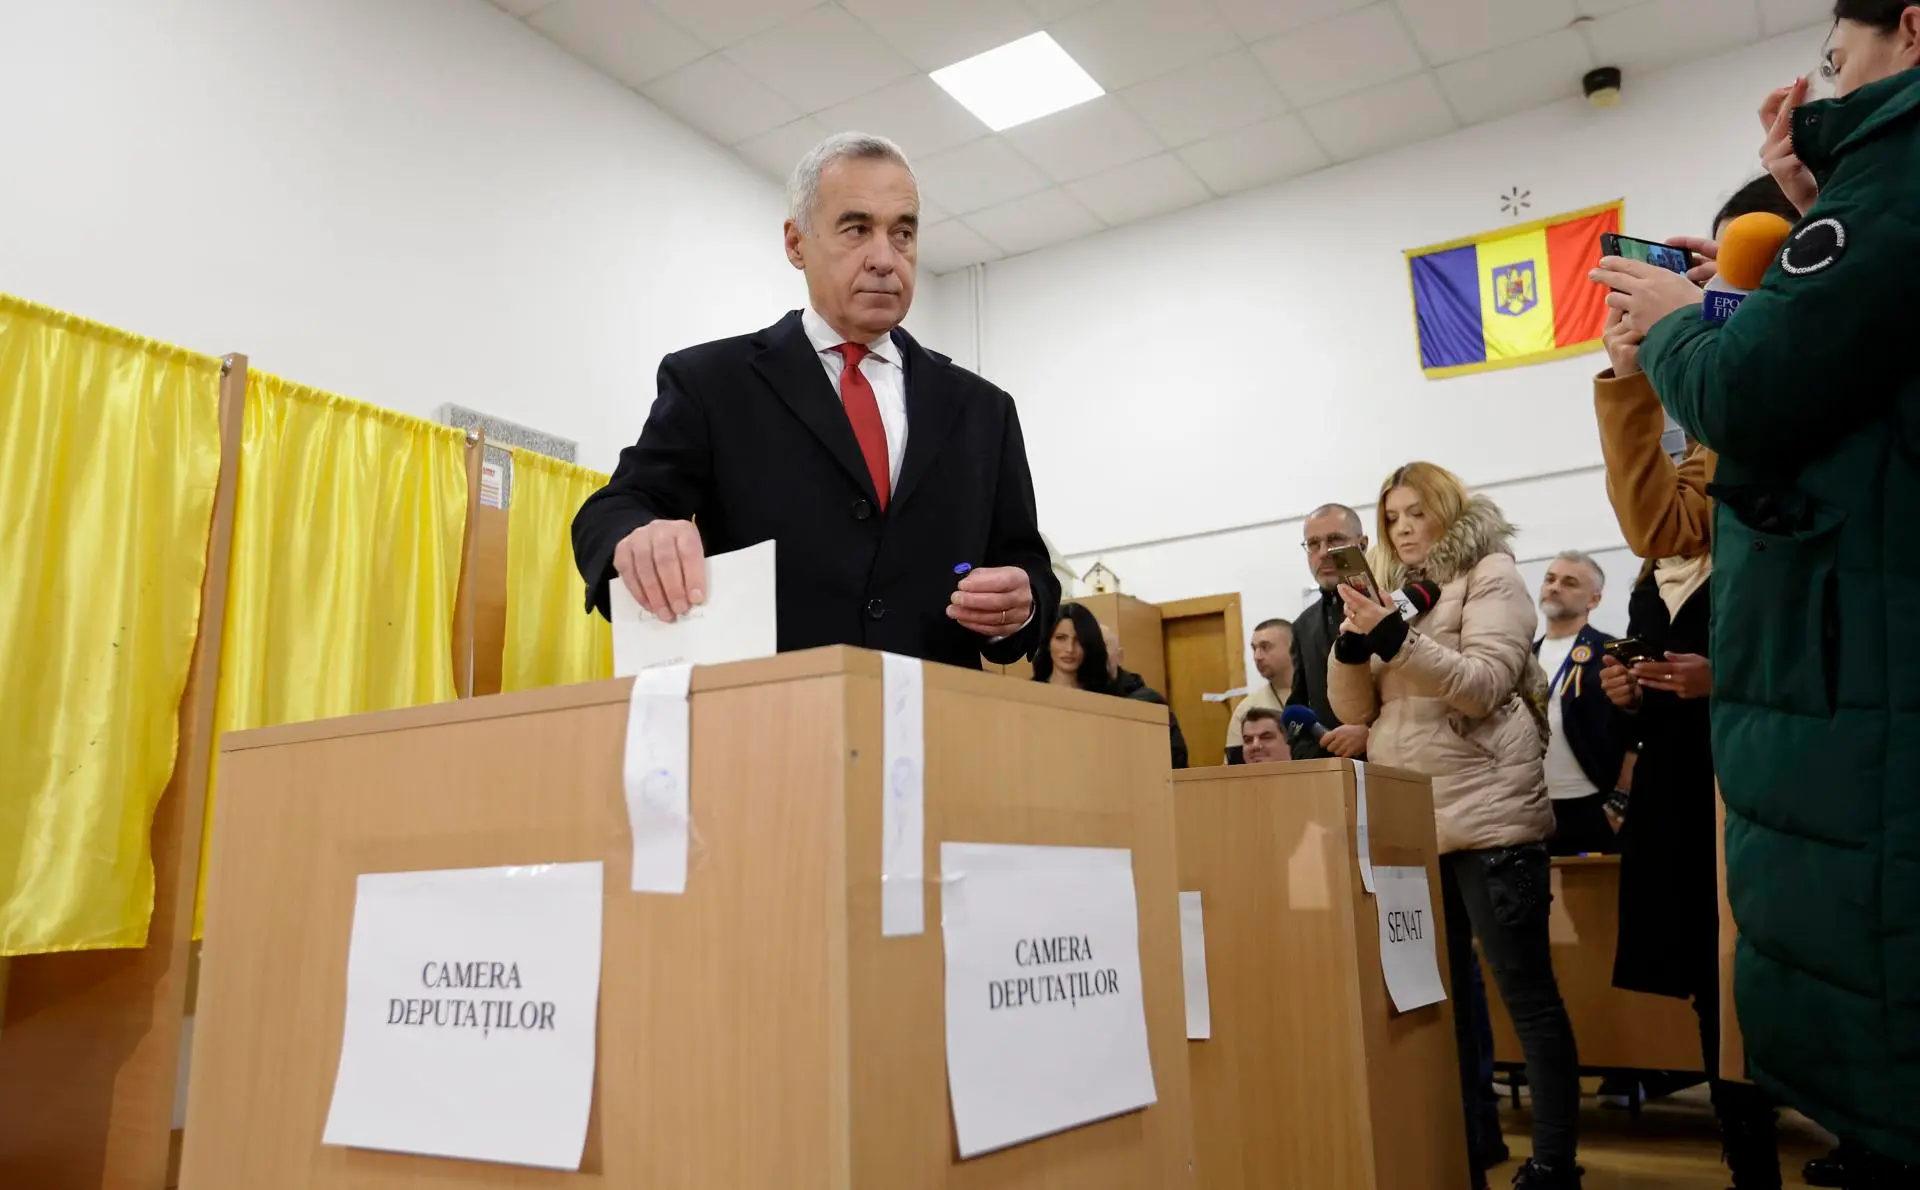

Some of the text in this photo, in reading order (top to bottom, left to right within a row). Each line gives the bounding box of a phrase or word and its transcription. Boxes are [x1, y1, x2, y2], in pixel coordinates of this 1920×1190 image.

[1713, 296, 1740, 309] EPO
[1387, 909, 1423, 944] SENAT
[1014, 934, 1093, 967] CAMERA
[421, 961, 523, 990] CAMERA
